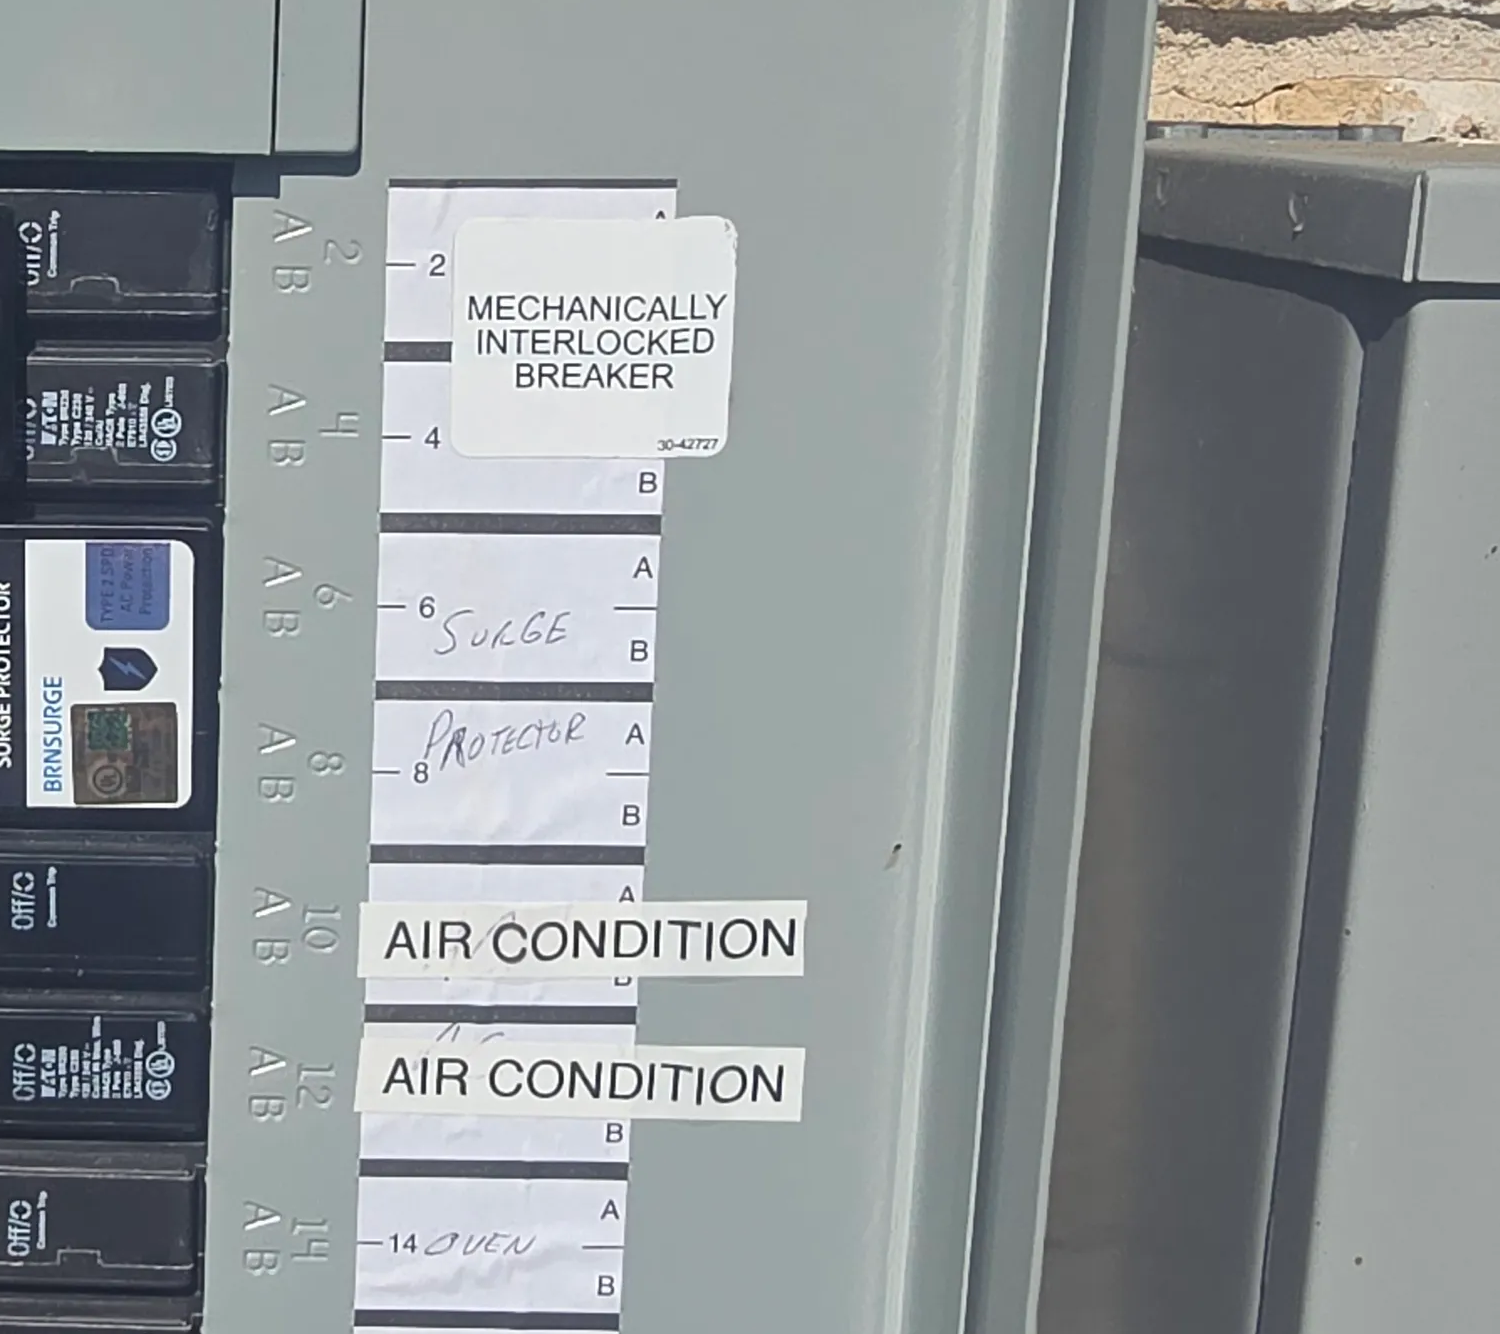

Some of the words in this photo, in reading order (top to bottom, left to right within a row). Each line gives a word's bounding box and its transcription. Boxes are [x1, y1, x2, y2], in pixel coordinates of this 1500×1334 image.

[430, 254, 445, 276] 2
[468, 293, 729, 321] MECHANICALLY
[476, 327, 716, 355] INTERLOCKED
[515, 362, 675, 389] BREAKER
[425, 427, 440, 449] 4
[634, 557, 652, 578] A
[99, 588, 115, 623] TYPE
[119, 594, 133, 614] AC
[420, 597, 434, 618] 6
[435, 609, 570, 656] SURGE
[631, 640, 648, 661] B
[41, 675, 64, 793] BRNSURGE
[424, 708, 586, 772] PROTECTOR
[626, 724, 644, 744] A
[414, 762, 428, 783] 8
[623, 805, 640, 825] B
[384, 920, 474, 960] AIR
[491, 918, 798, 965] CONDITION
[382, 1057, 469, 1097] AIR
[488, 1057, 786, 1106] CONDITION
[391, 1234, 416, 1253] 14
[425, 1231, 536, 1257] OVEN
